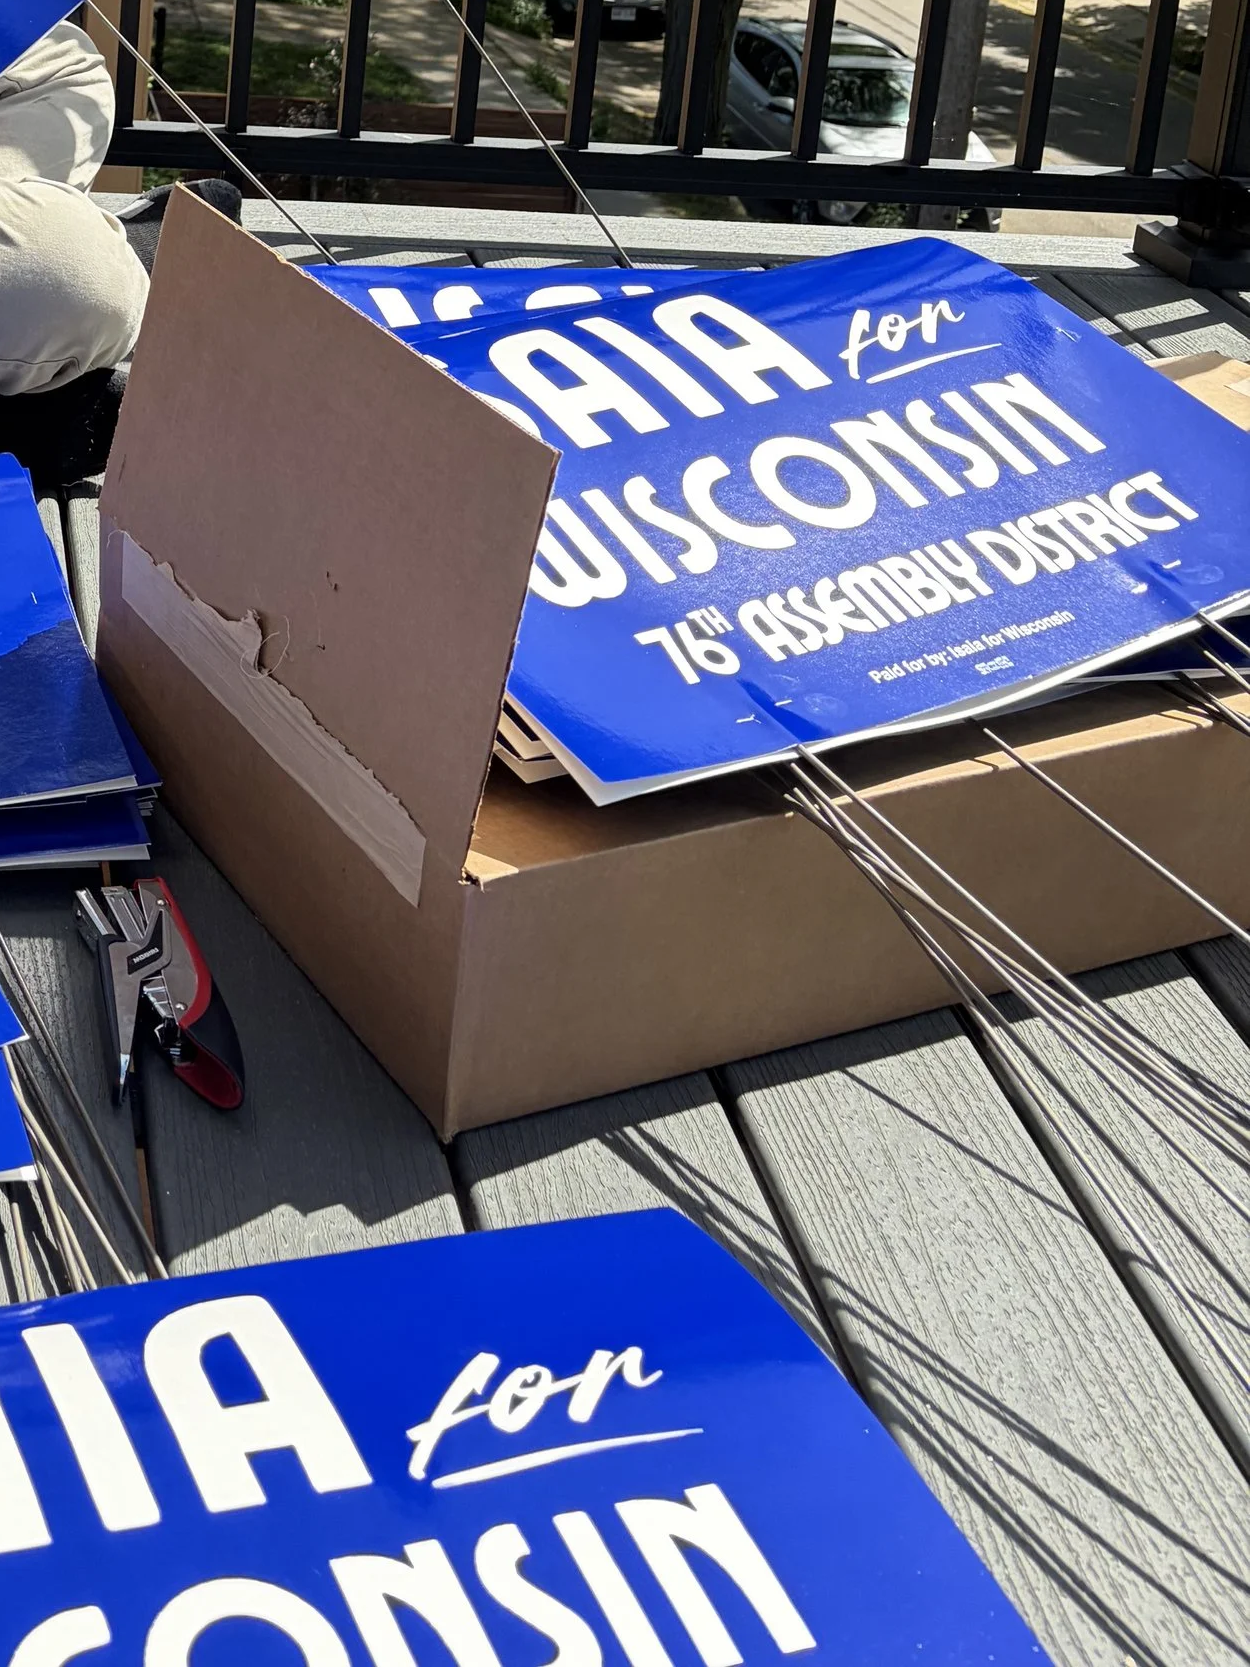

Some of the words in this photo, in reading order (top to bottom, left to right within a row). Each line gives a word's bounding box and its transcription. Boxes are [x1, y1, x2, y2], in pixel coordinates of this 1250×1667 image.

[472, 295, 833, 449] AIA
[838, 300, 965, 380] for
[529, 372, 1107, 608] WISCONSIN
[633, 604, 740, 685] 76TH
[738, 540, 993, 662] ASSEMBLY
[965, 471, 1199, 585] DISTRICT
[868, 666, 906, 684] Paid
[902, 658, 926, 673] for
[923, 650, 952, 667] by:
[947, 640, 986, 659] Isaia
[981, 633, 1005, 648] for
[1000, 610, 1076, 642] Wisconsin
[406, 1347, 662, 1480] for
